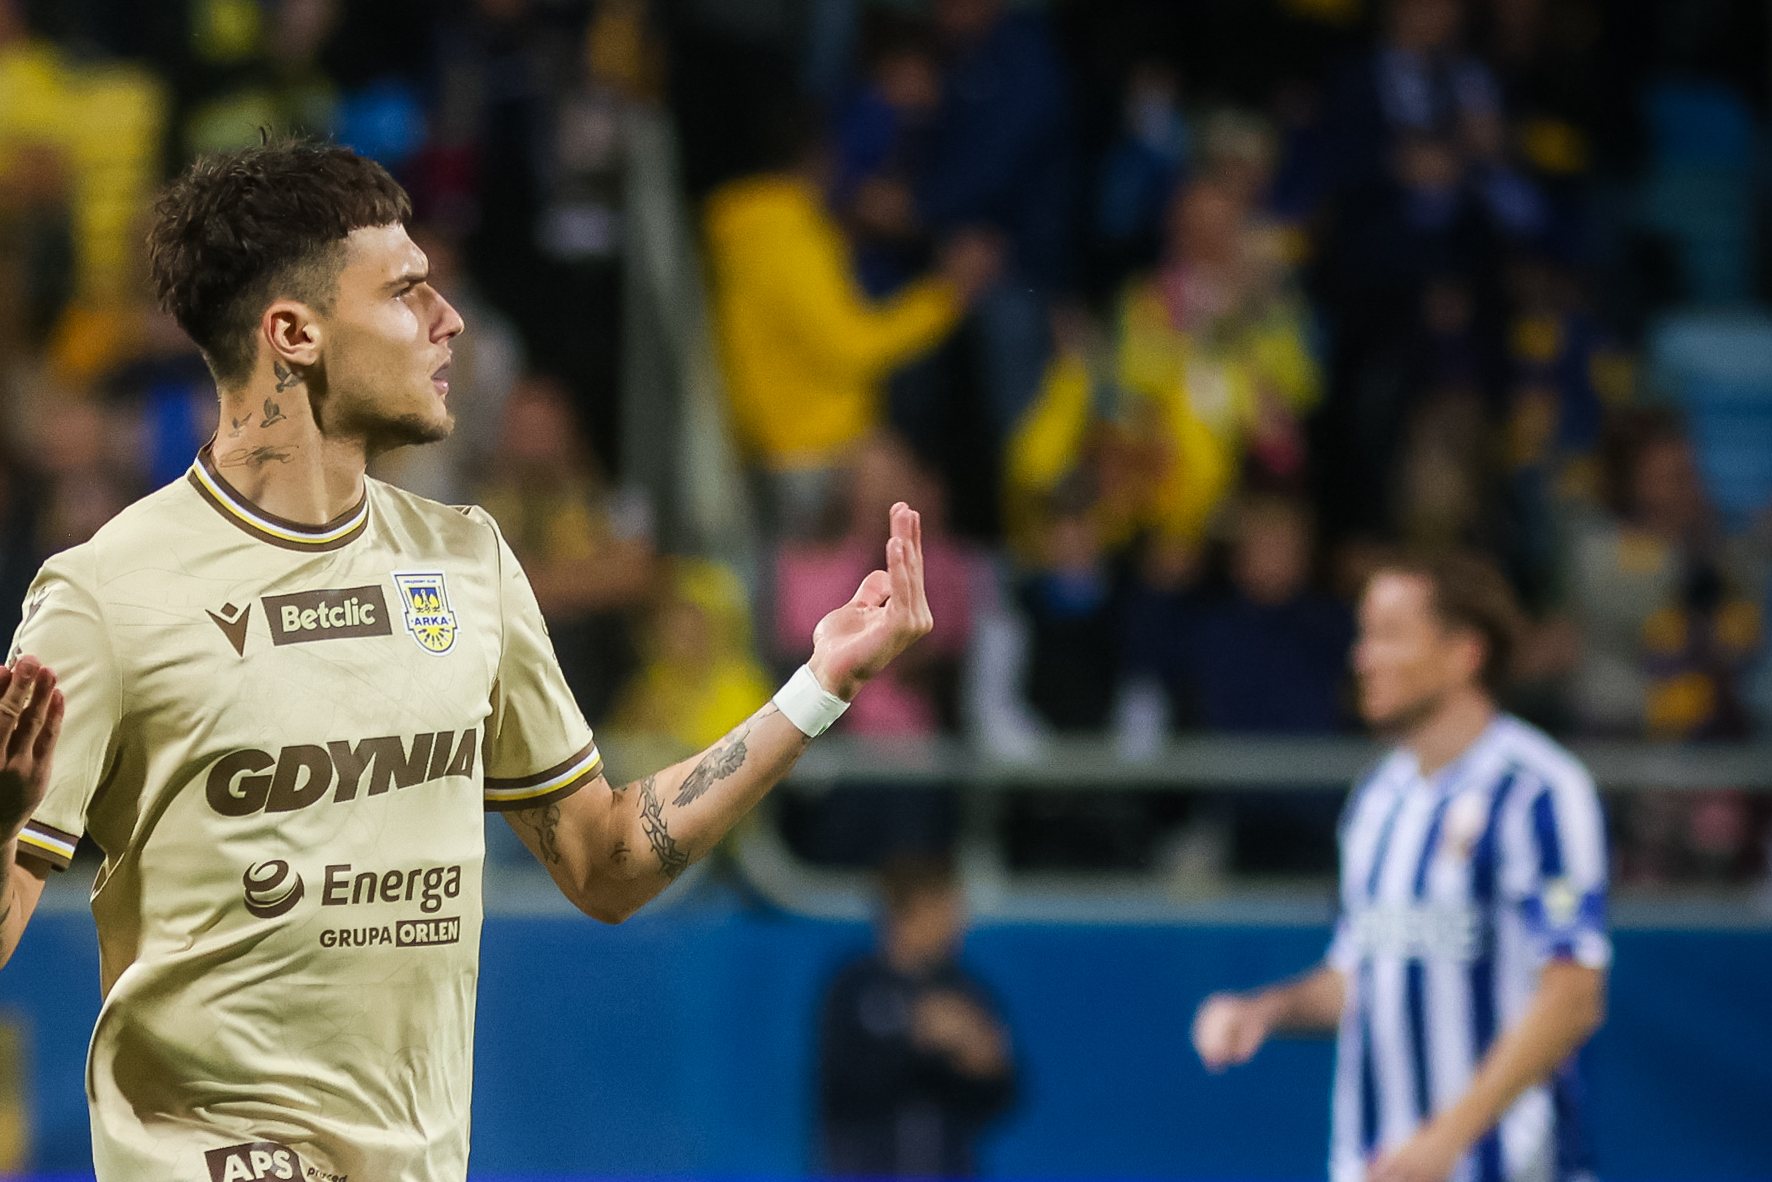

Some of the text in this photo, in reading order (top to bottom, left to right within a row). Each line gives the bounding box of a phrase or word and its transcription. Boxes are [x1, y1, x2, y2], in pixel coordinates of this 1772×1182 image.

[280, 597, 375, 633] Betclic
[414, 616, 448, 627] ARKA
[204, 728, 477, 817] GDYNIA
[321, 863, 461, 914] Energa
[319, 920, 459, 948] GRUPA ORLEN
